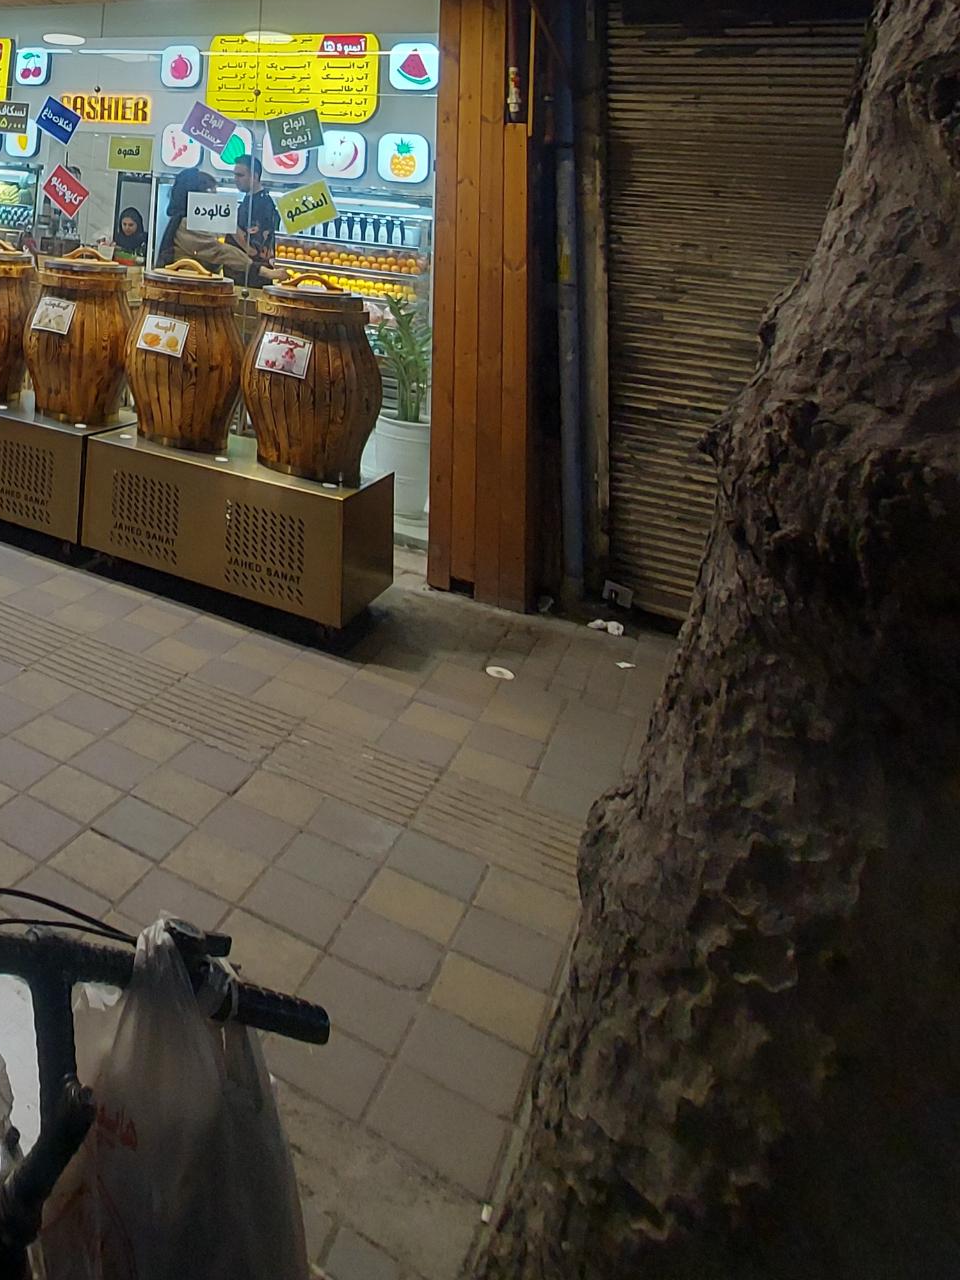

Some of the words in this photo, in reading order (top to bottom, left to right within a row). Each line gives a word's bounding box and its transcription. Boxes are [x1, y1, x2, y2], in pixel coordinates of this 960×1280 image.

[322, 61, 355, 70] انار
[201, 114, 224, 129] انواع
[283, 116, 305, 134] انواع
[280, 128, 311, 149] آبمیوه
[117, 145, 141, 157] قهوه
[194, 204, 231, 220] فالوده
[23, 494, 48, 509] SANAT
[113, 521, 143, 539] JAHED
[145, 530, 176, 547] SANAT
[227, 556, 263, 575] JAHED
[266, 565, 302, 586] SANAT
